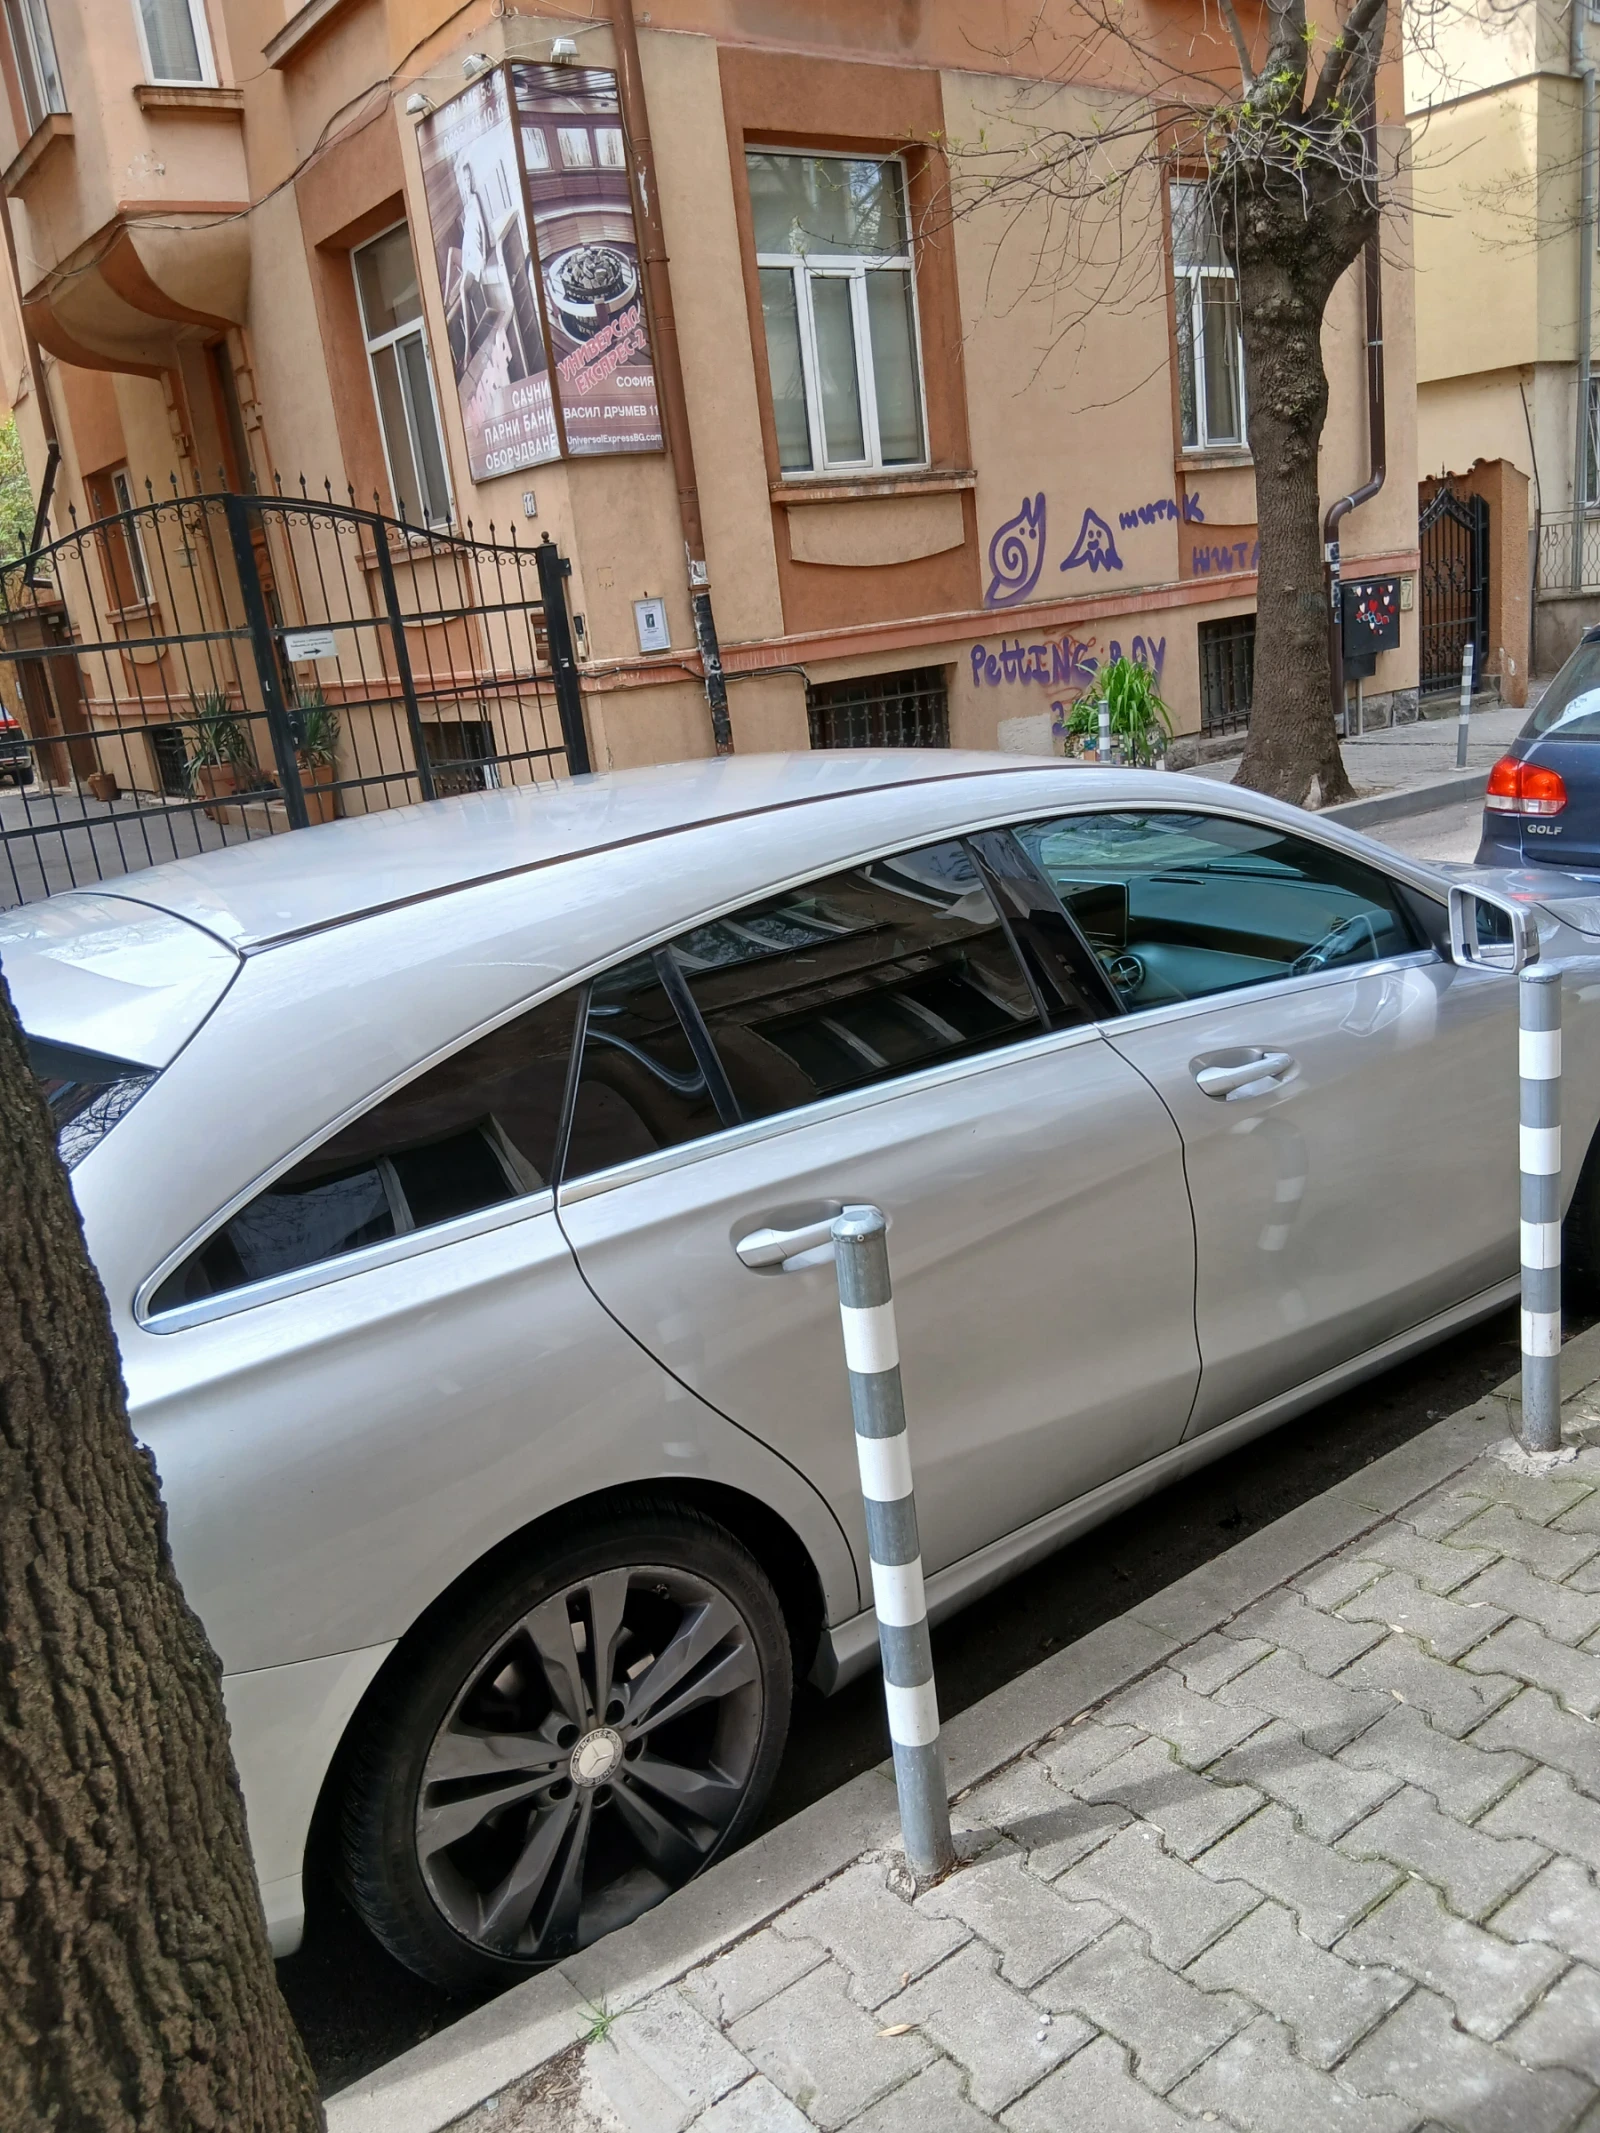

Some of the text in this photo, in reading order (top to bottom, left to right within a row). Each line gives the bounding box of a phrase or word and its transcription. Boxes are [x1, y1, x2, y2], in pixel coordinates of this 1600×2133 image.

[483, 107, 494, 128] 10
[496, 98, 507, 119] 10
[558, 305, 641, 382] УНИВЕРСАЛ
[575, 328, 647, 396] ЕКСПРЕС-2
[512, 379, 551, 408] САУНИ
[616, 375, 654, 388] СОФИЯ
[484, 406, 553, 446] ПАРНИ БАНИ
[564, 406, 600, 419] ВАСИЛ
[604, 405, 647, 419] ДРУМЕВ
[485, 434, 557, 470] ОБОРУДВАНЕ
[1527, 824, 1562, 836] GOLF
[574, 1731, 608, 1760] MERCEDES
